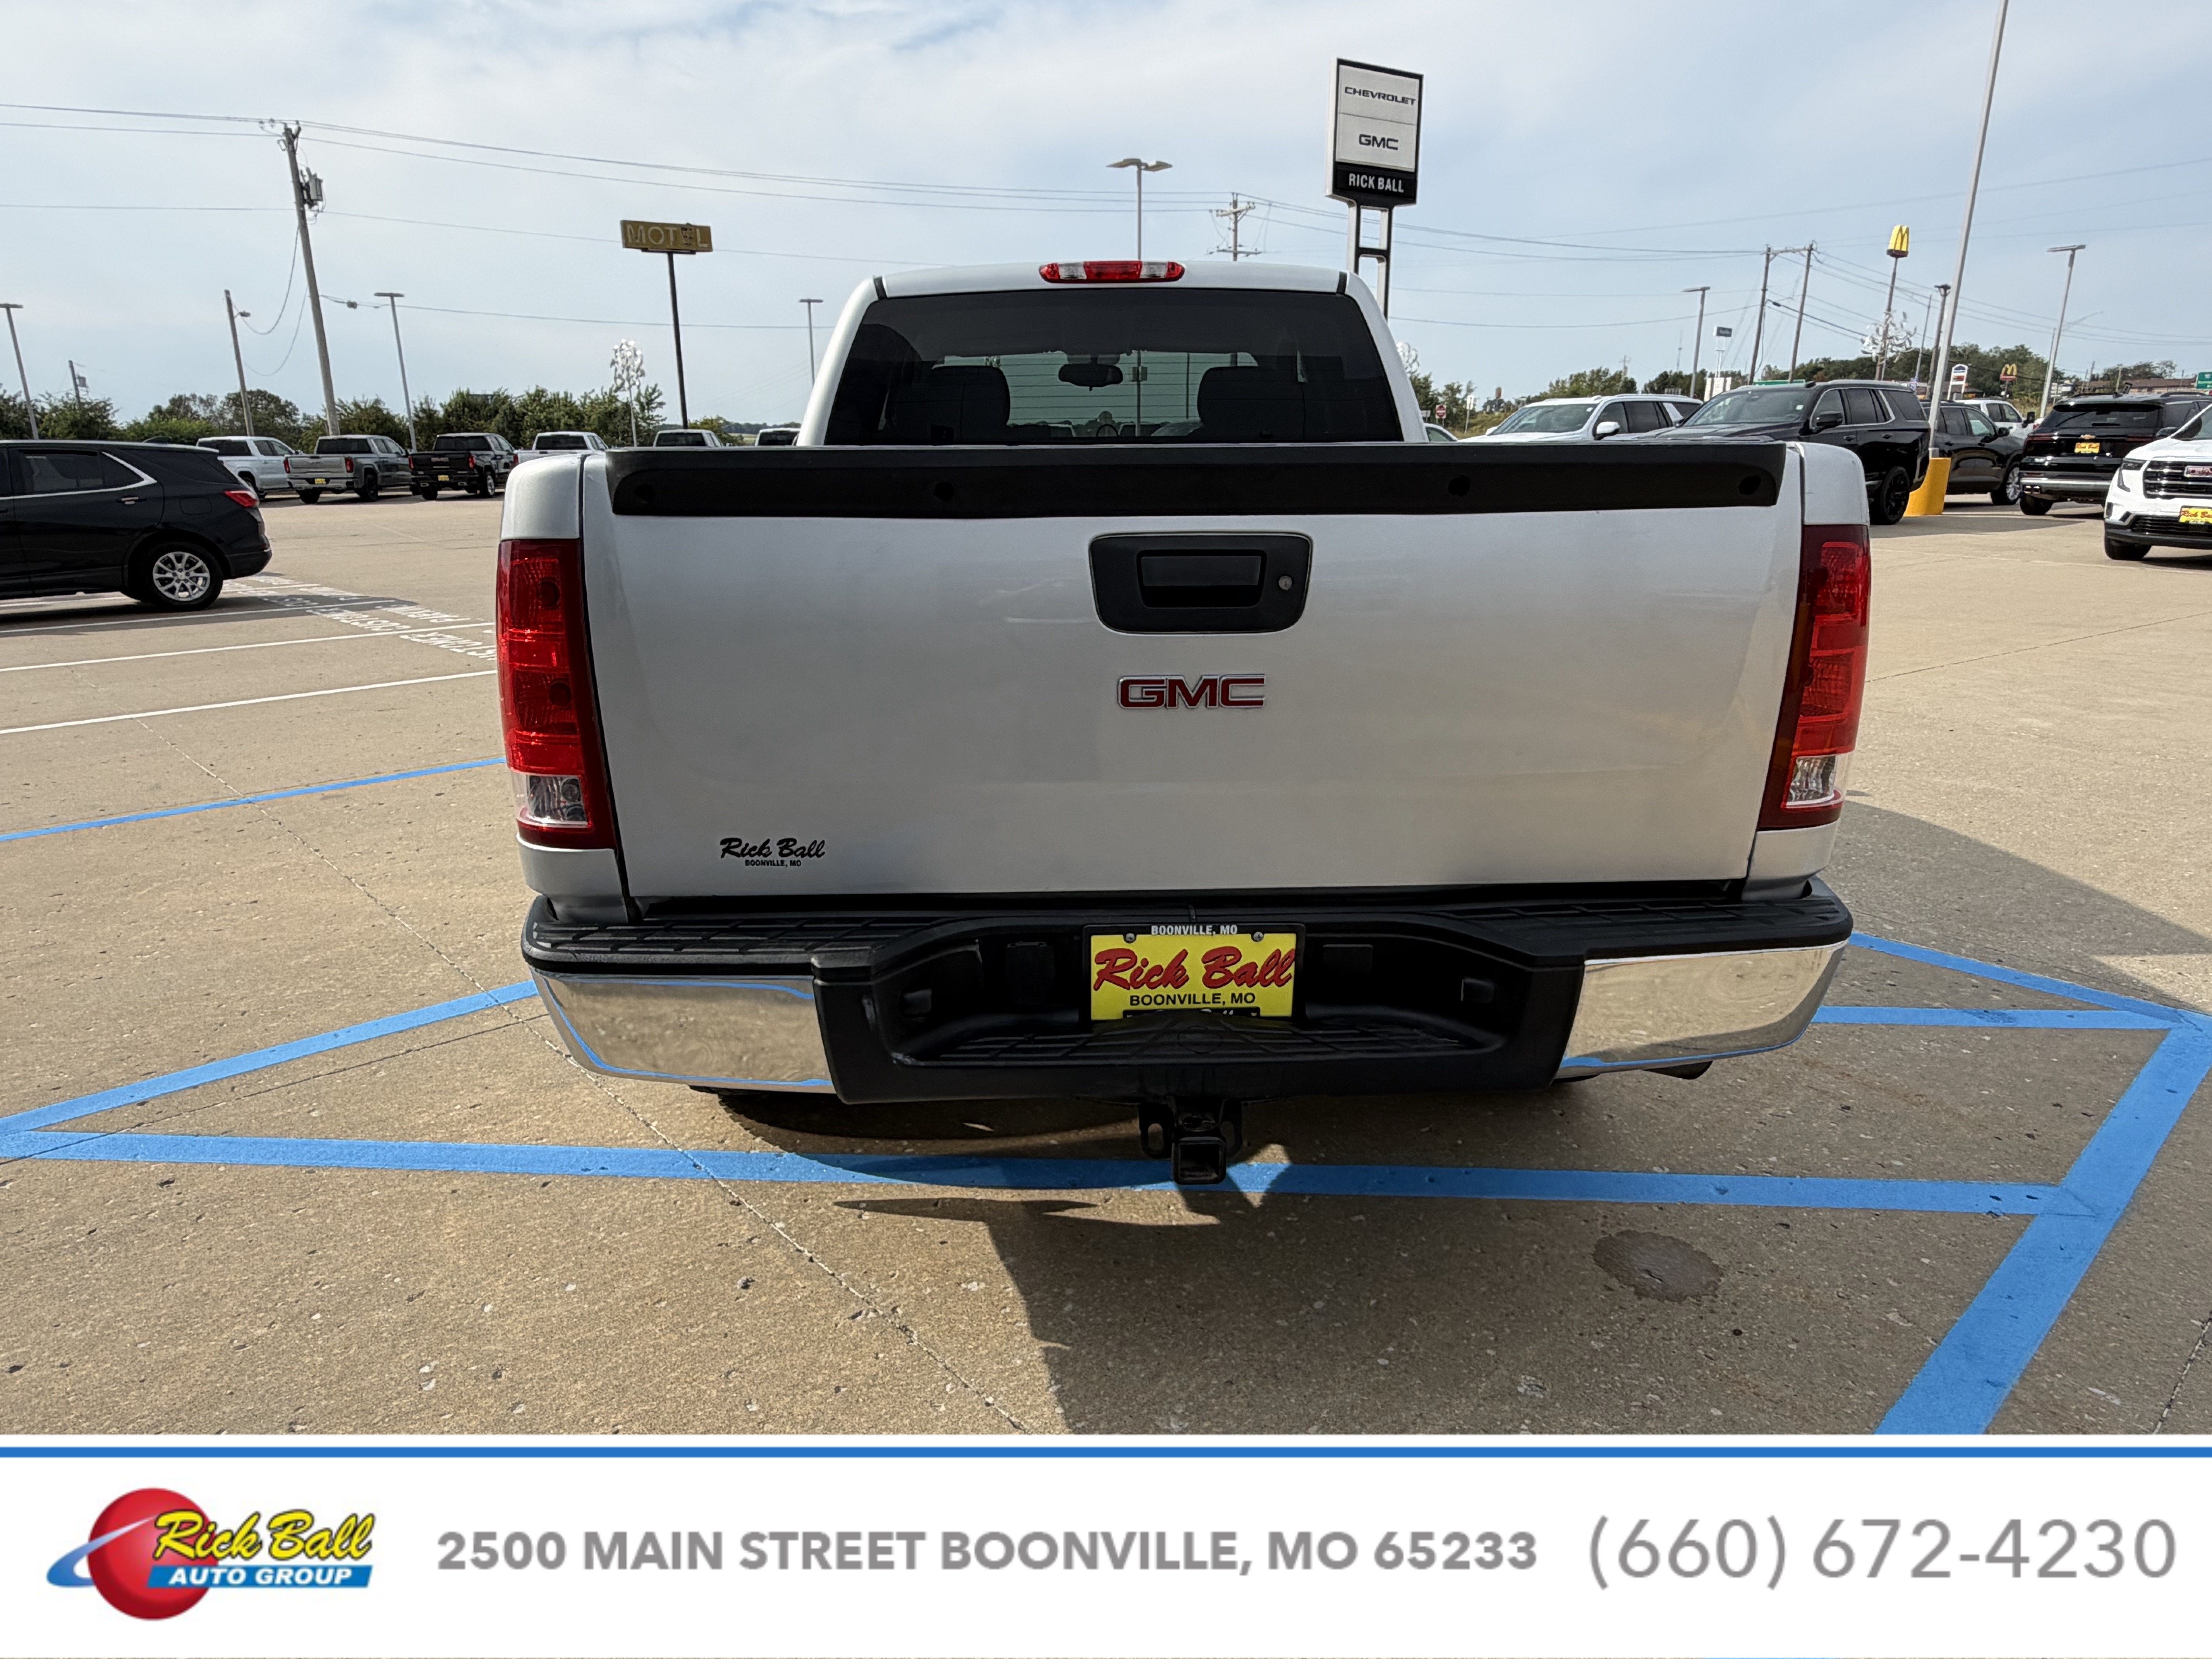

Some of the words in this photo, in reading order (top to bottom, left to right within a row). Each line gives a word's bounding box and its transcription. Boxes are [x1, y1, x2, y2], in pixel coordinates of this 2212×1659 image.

[1345, 86, 1416, 105] CHEVROLET
[1359, 134, 1398, 150] GMC
[1349, 173, 1375, 189] RICK
[1378, 177, 1404, 193] BALL
[626, 224, 709, 247] MOTEL
[1118, 674, 1266, 709] GMC
[720, 838, 772, 859] Rick
[776, 838, 826, 858] Ball
[1151, 925, 1216, 936] BOONVILLE,
[1220, 925, 1238, 935] MO
[1093, 948, 1190, 991] Rick
[1201, 946, 1296, 989] Ball
[1130, 993, 1226, 1006] BOONVILLE,
[1230, 992, 1256, 1004] MO
